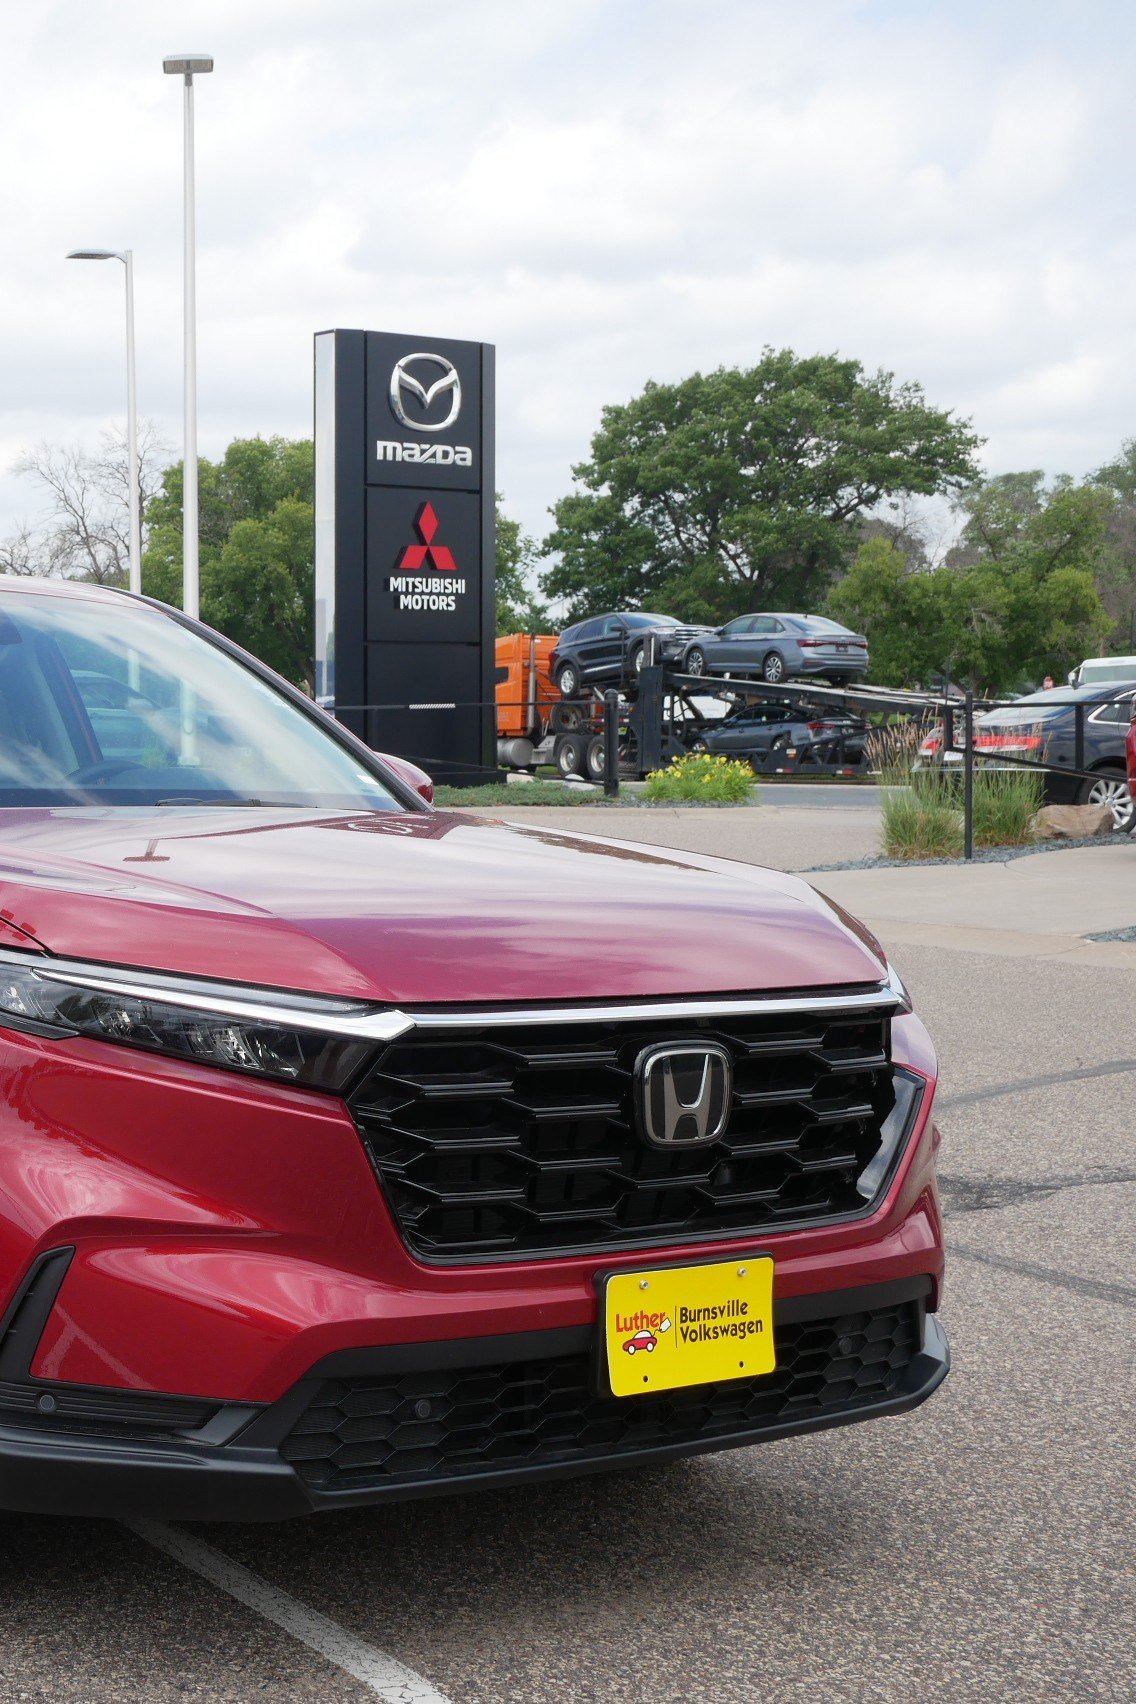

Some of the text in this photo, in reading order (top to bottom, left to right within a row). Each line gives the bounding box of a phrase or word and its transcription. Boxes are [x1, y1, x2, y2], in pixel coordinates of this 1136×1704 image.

[389, 577, 466, 594] MITSUBISHI
[400, 595, 456, 611] MOTORS
[615, 1310, 666, 1333] Luther
[679, 1299, 749, 1324] Burnsville
[679, 1319, 763, 1344] Volkswagen
